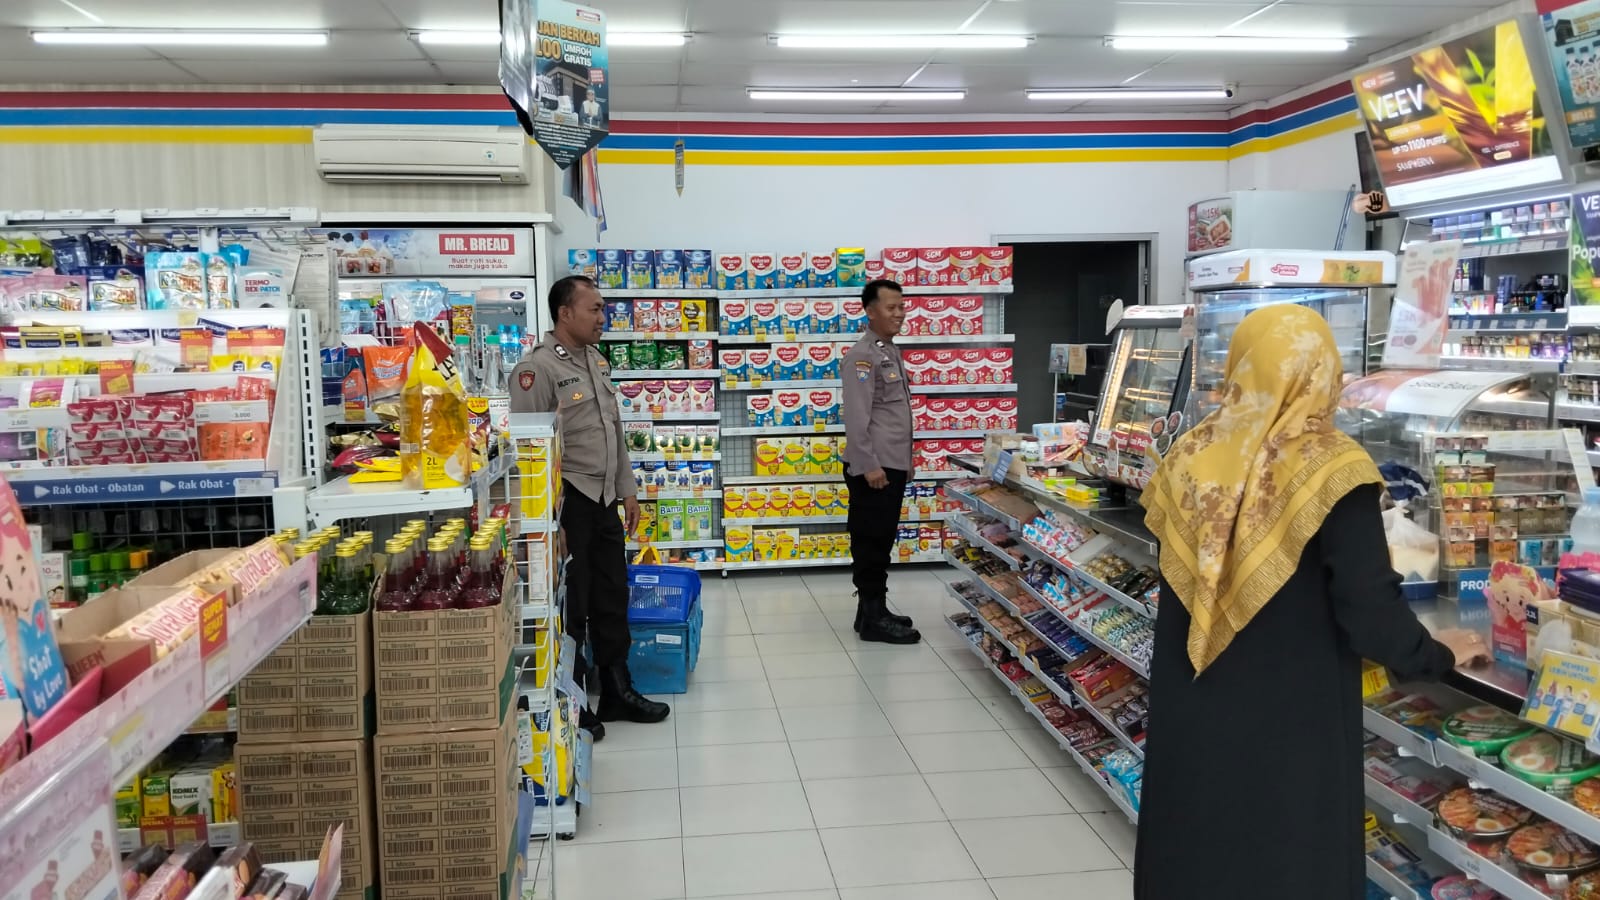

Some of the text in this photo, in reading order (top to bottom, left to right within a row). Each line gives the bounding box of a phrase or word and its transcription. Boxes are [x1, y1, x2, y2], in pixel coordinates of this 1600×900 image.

[560, 24, 600, 47] BERKAH
[563, 43, 592, 57] UMROH
[563, 54, 592, 67] GRATIS
[1368, 83, 1423, 122] VEEV
[444, 238, 510, 251] MR. BREAD
[893, 250, 908, 259] SGM
[926, 250, 941, 259] SGM
[927, 300, 944, 309] SGM
[959, 300, 976, 308] SGM
[910, 353, 925, 361] SGM
[937, 352, 952, 360] SGM
[964, 352, 979, 360] SGM
[991, 351, 1006, 359] SGM
[932, 401, 946, 409] SGM
[427, 457, 437, 466] 2L
[53, 484, 72, 495] Rak
[75, 484, 98, 494] Obat
[108, 482, 144, 493] Obatan
[178, 479, 197, 490] Rak
[199, 478, 223, 489] Obat
[203, 598, 224, 623] SUPER
[33, 690, 47, 711] by
